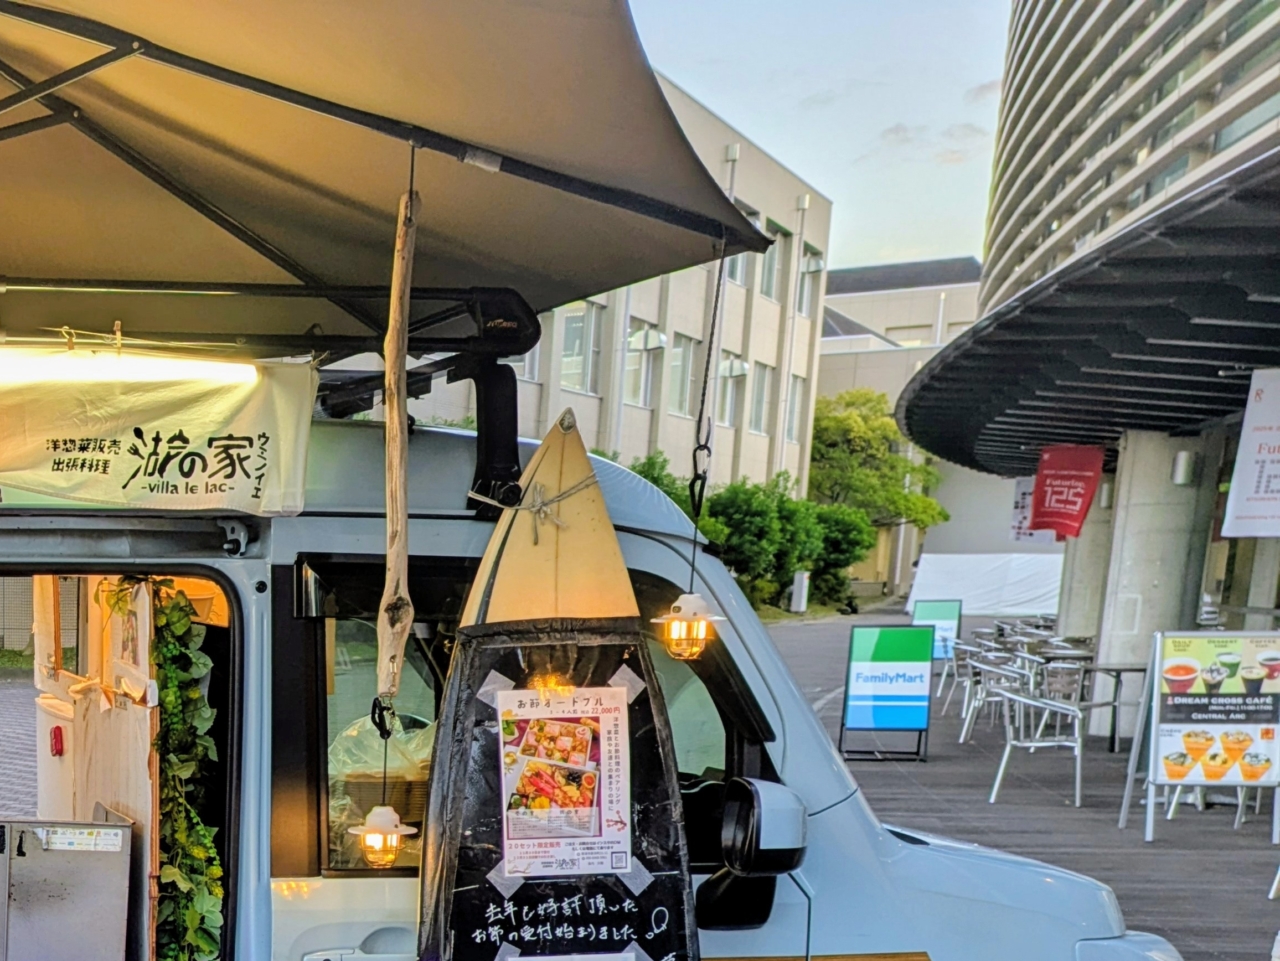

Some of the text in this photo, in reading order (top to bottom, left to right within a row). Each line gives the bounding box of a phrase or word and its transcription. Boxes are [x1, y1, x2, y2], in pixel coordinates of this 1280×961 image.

[45, 438, 122, 455] 洋惣菜販売
[51, 457, 111, 475] 出張料理
[184, 481, 199, 494] le
[855, 672, 925, 684] FamilyMart
[517, 697, 604, 710] お節オードブル
